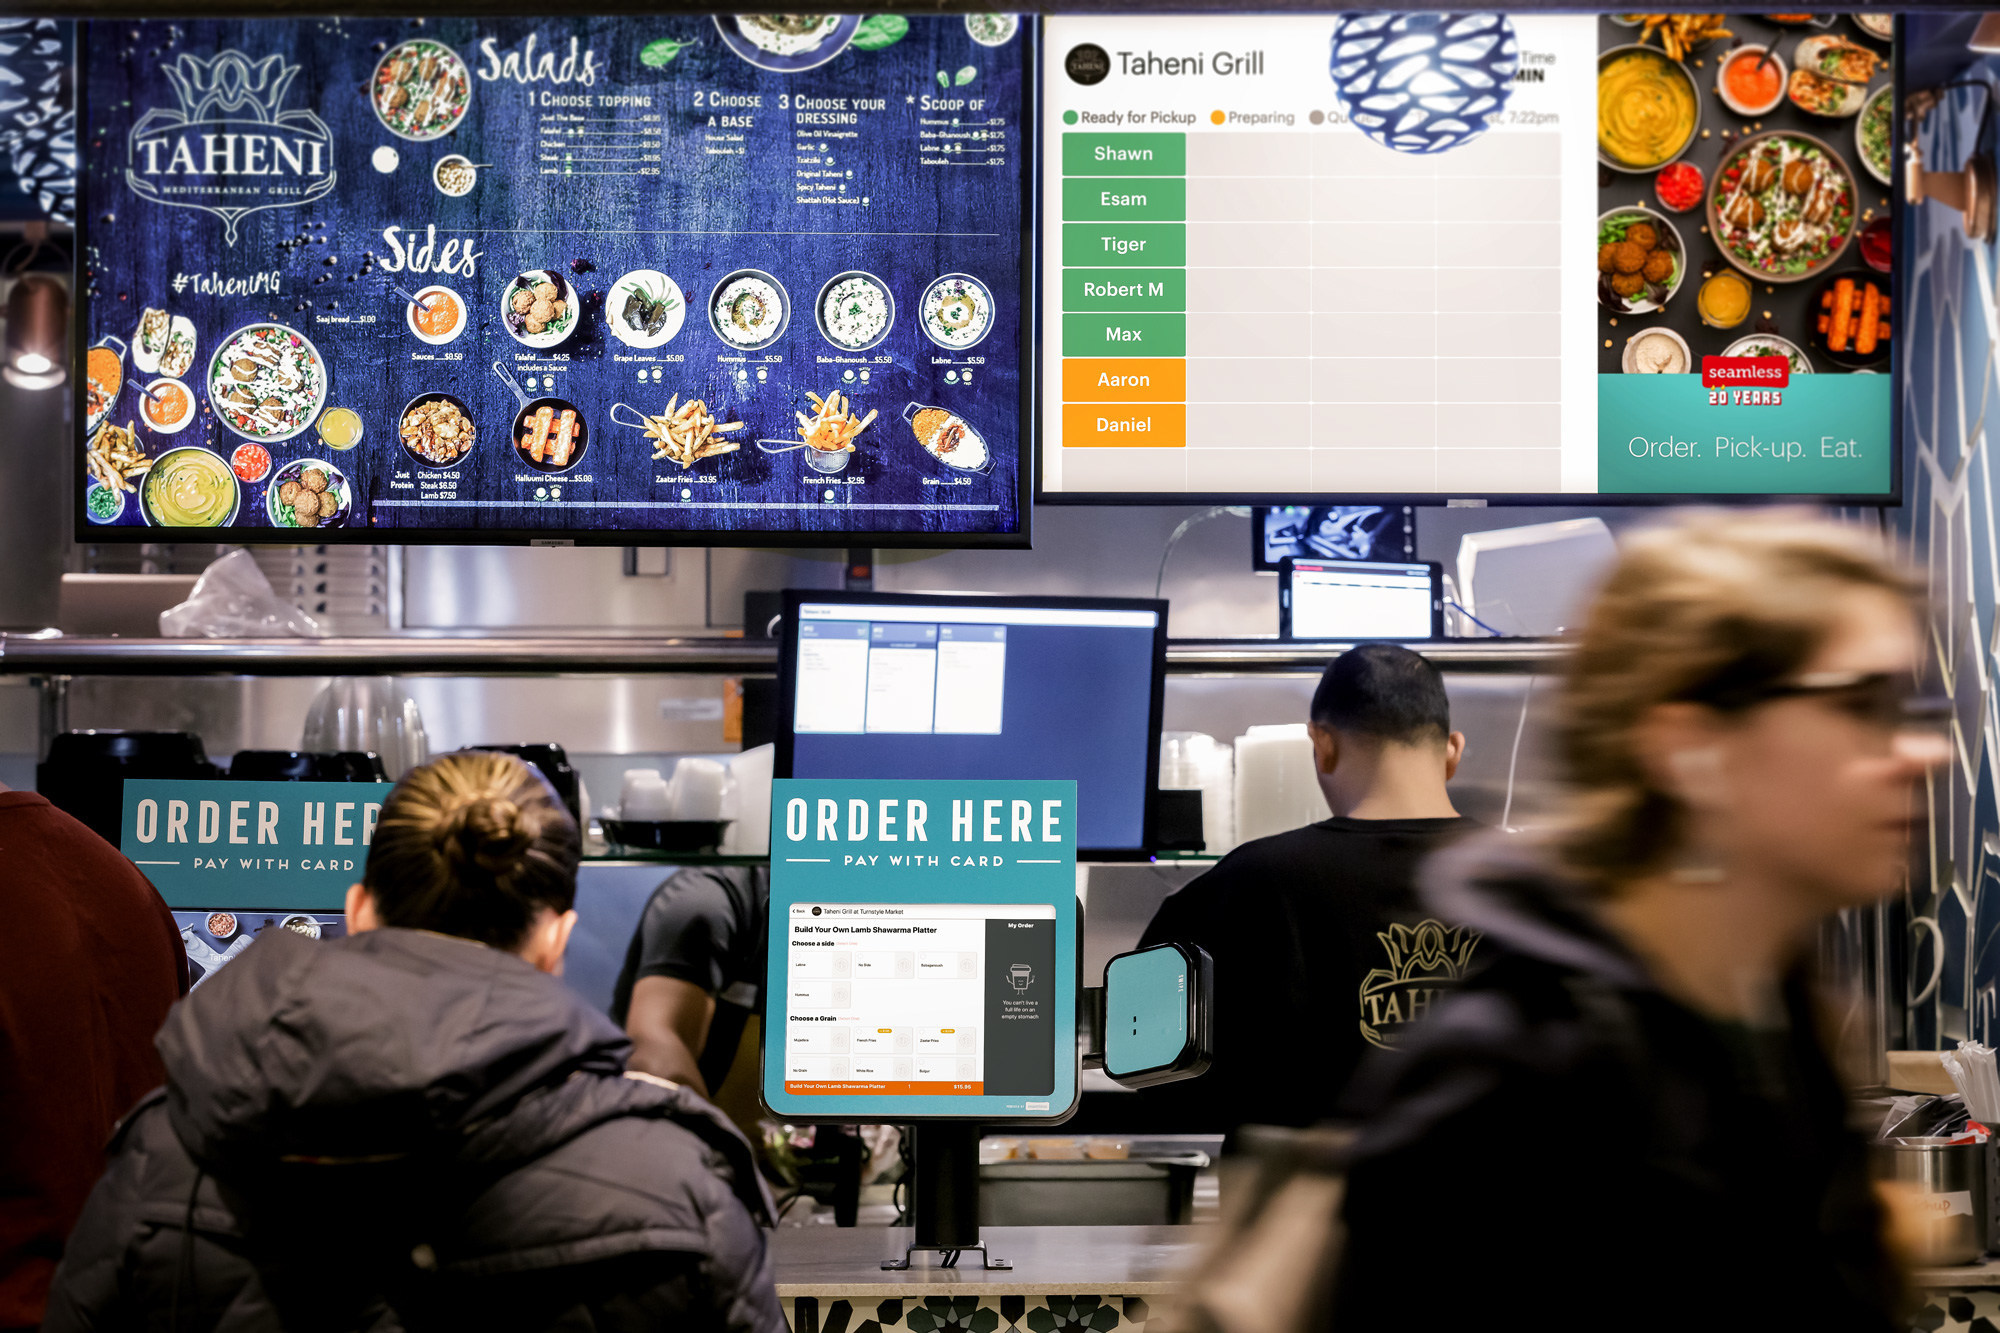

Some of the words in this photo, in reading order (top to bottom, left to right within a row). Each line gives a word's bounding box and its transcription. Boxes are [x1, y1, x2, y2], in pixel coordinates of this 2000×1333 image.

[477, 33, 603, 87] Salads
[1116, 51, 1204, 75] Taheni
[1212, 51, 1264, 76] Grill
[1521, 51, 1556, 65] Time
[529, 91, 535, 106] 1
[694, 91, 703, 107] 2
[779, 94, 789, 110] 3
[852, 99, 886, 110] YOUR
[969, 99, 986, 111] OF
[708, 116, 716, 127] A
[721, 116, 754, 127] BASE
[797, 113, 857, 124] DRESSING
[1081, 111, 1123, 126] Ready
[1127, 111, 1146, 124] for
[1150, 111, 1196, 126] Pickup
[1229, 111, 1295, 126] Preparing
[137, 134, 325, 175] TAHENI
[1094, 146, 1153, 161] Shawn
[163, 186, 260, 194] MEDITERRANEAN
[269, 187, 302, 195] GRILL
[1101, 192, 1147, 206] Esam
[379, 223, 484, 278] Sides
[1101, 236, 1147, 255] Tiger
[1084, 282, 1143, 297] Robert
[1149, 283, 1164, 297] M
[331, 315, 350, 323] bread
[1106, 327, 1142, 342] Max
[411, 353, 434, 361] Sauces
[614, 355, 633, 363] Grape
[1708, 365, 1783, 379] seamless
[1097, 372, 1150, 387] Aaron
[1708, 390, 1728, 406] 20
[1733, 390, 1782, 406] YEARS
[1096, 417, 1151, 432] Daniel
[1628, 435, 1701, 458] Order.
[1715, 435, 1806, 462] Pick-up.
[1820, 436, 1863, 458] Eat.
[395, 471, 410, 479] Just
[417, 471, 442, 479] Chicken
[655, 475, 676, 483] Zaatar
[678, 475, 692, 483] Fries
[922, 477, 940, 485] Grain
[391, 481, 414, 489] Protein
[420, 481, 438, 489] Steak
[136, 798, 279, 845] ORDER
[302, 801, 383, 846] HER
[786, 798, 928, 842] ORDER
[951, 799, 1062, 842] HERE
[194, 857, 229, 869] PAY
[239, 858, 290, 870] WITH
[301, 859, 354, 871] CARD
[844, 855, 879, 866] PAY
[889, 856, 939, 867] WITH
[950, 856, 1004, 867] CARD
[873, 926, 911, 934] Shawarma
